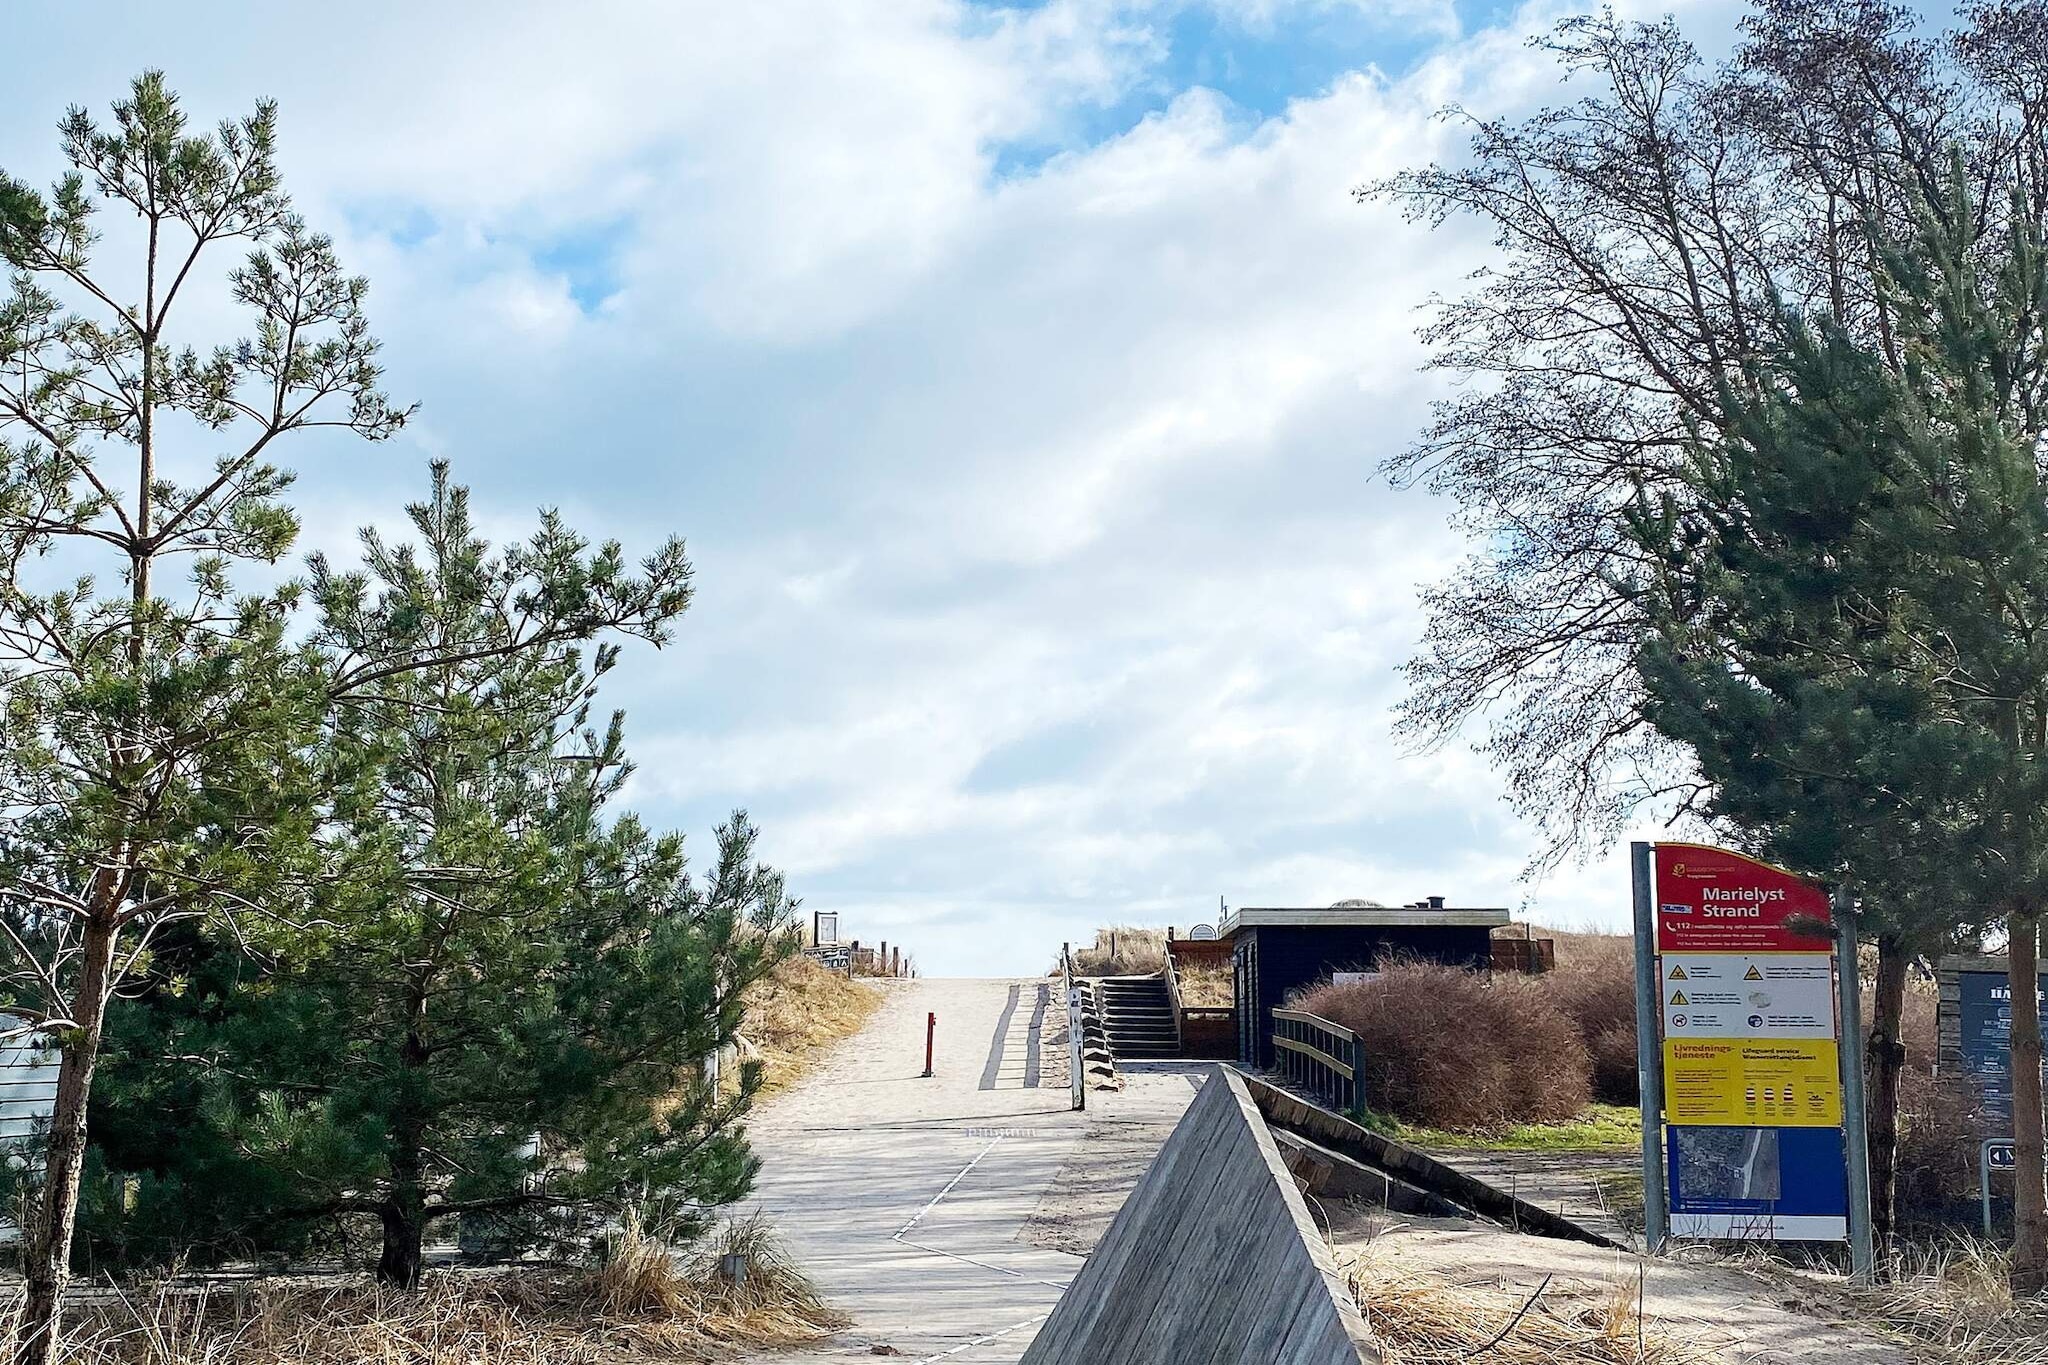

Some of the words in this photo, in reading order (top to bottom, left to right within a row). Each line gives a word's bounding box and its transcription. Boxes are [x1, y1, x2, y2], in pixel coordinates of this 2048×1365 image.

[1703, 887, 1785, 903] Marielyst
[1703, 905, 1760, 917] Strand
[1676, 922, 1690, 930] 112
[1674, 1044, 1735, 1054] Livrednings-
[1674, 1052, 1715, 1060] tjeneste
